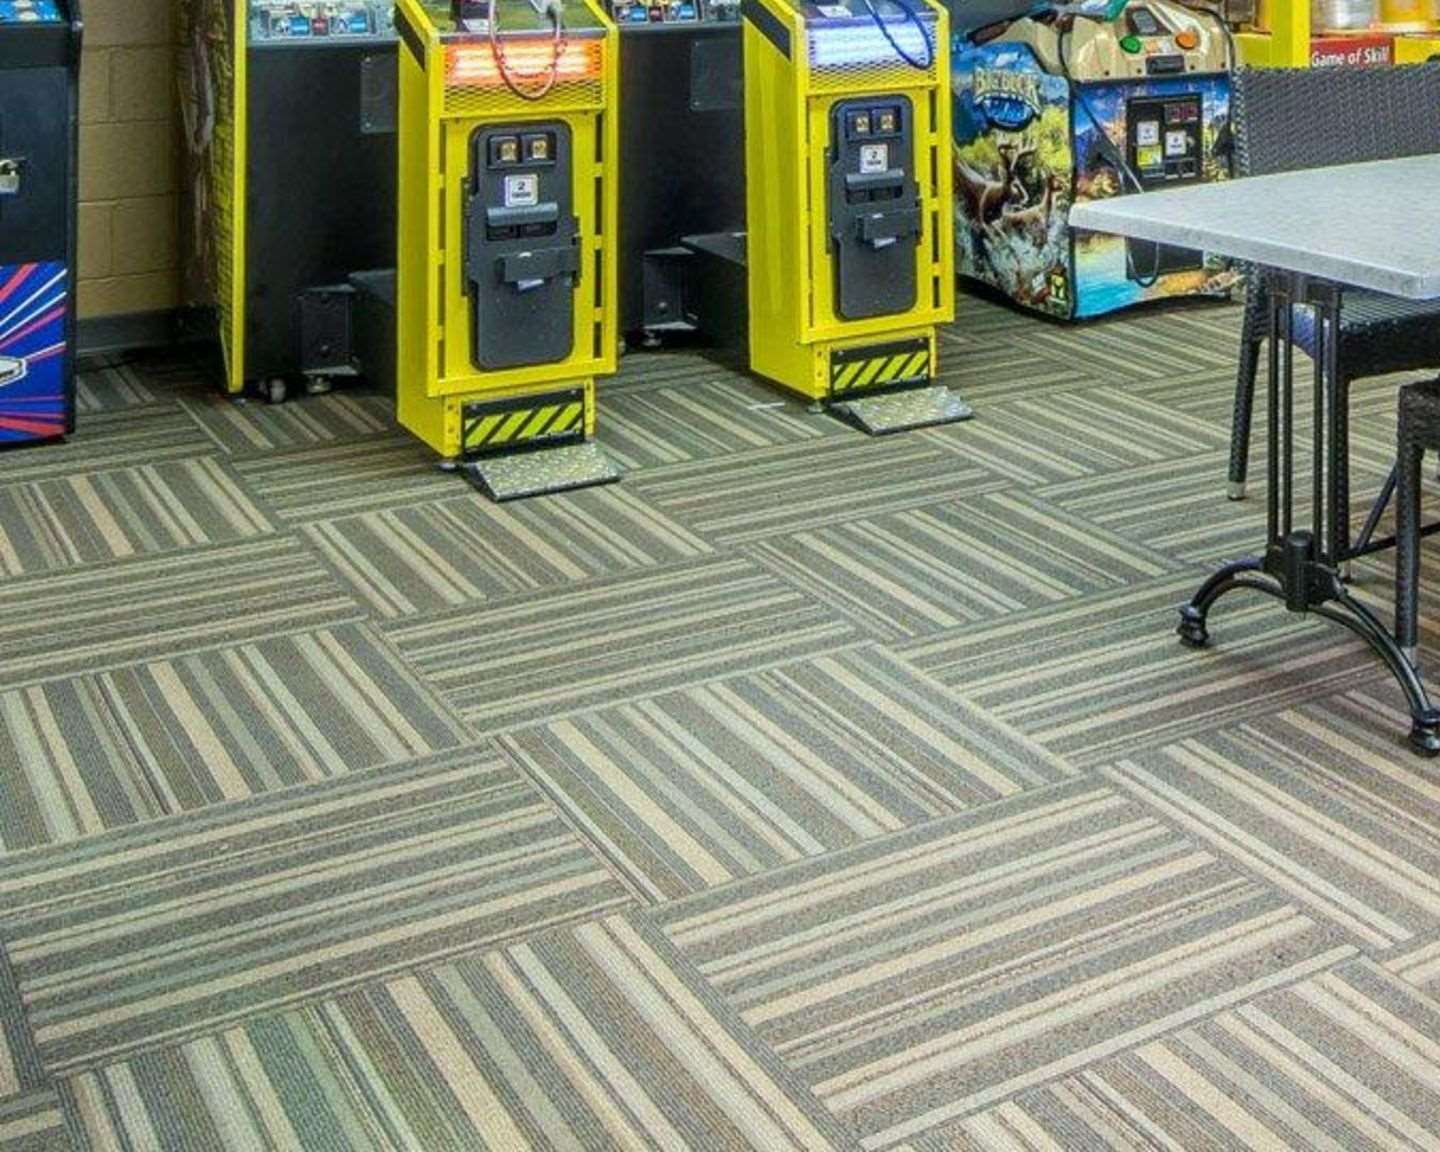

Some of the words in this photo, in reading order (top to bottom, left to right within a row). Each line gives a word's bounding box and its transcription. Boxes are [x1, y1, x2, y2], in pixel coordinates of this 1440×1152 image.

[1312, 50, 1344, 66] Game
[1348, 48, 1360, 64] of
[1364, 46, 1389, 63] Skill
